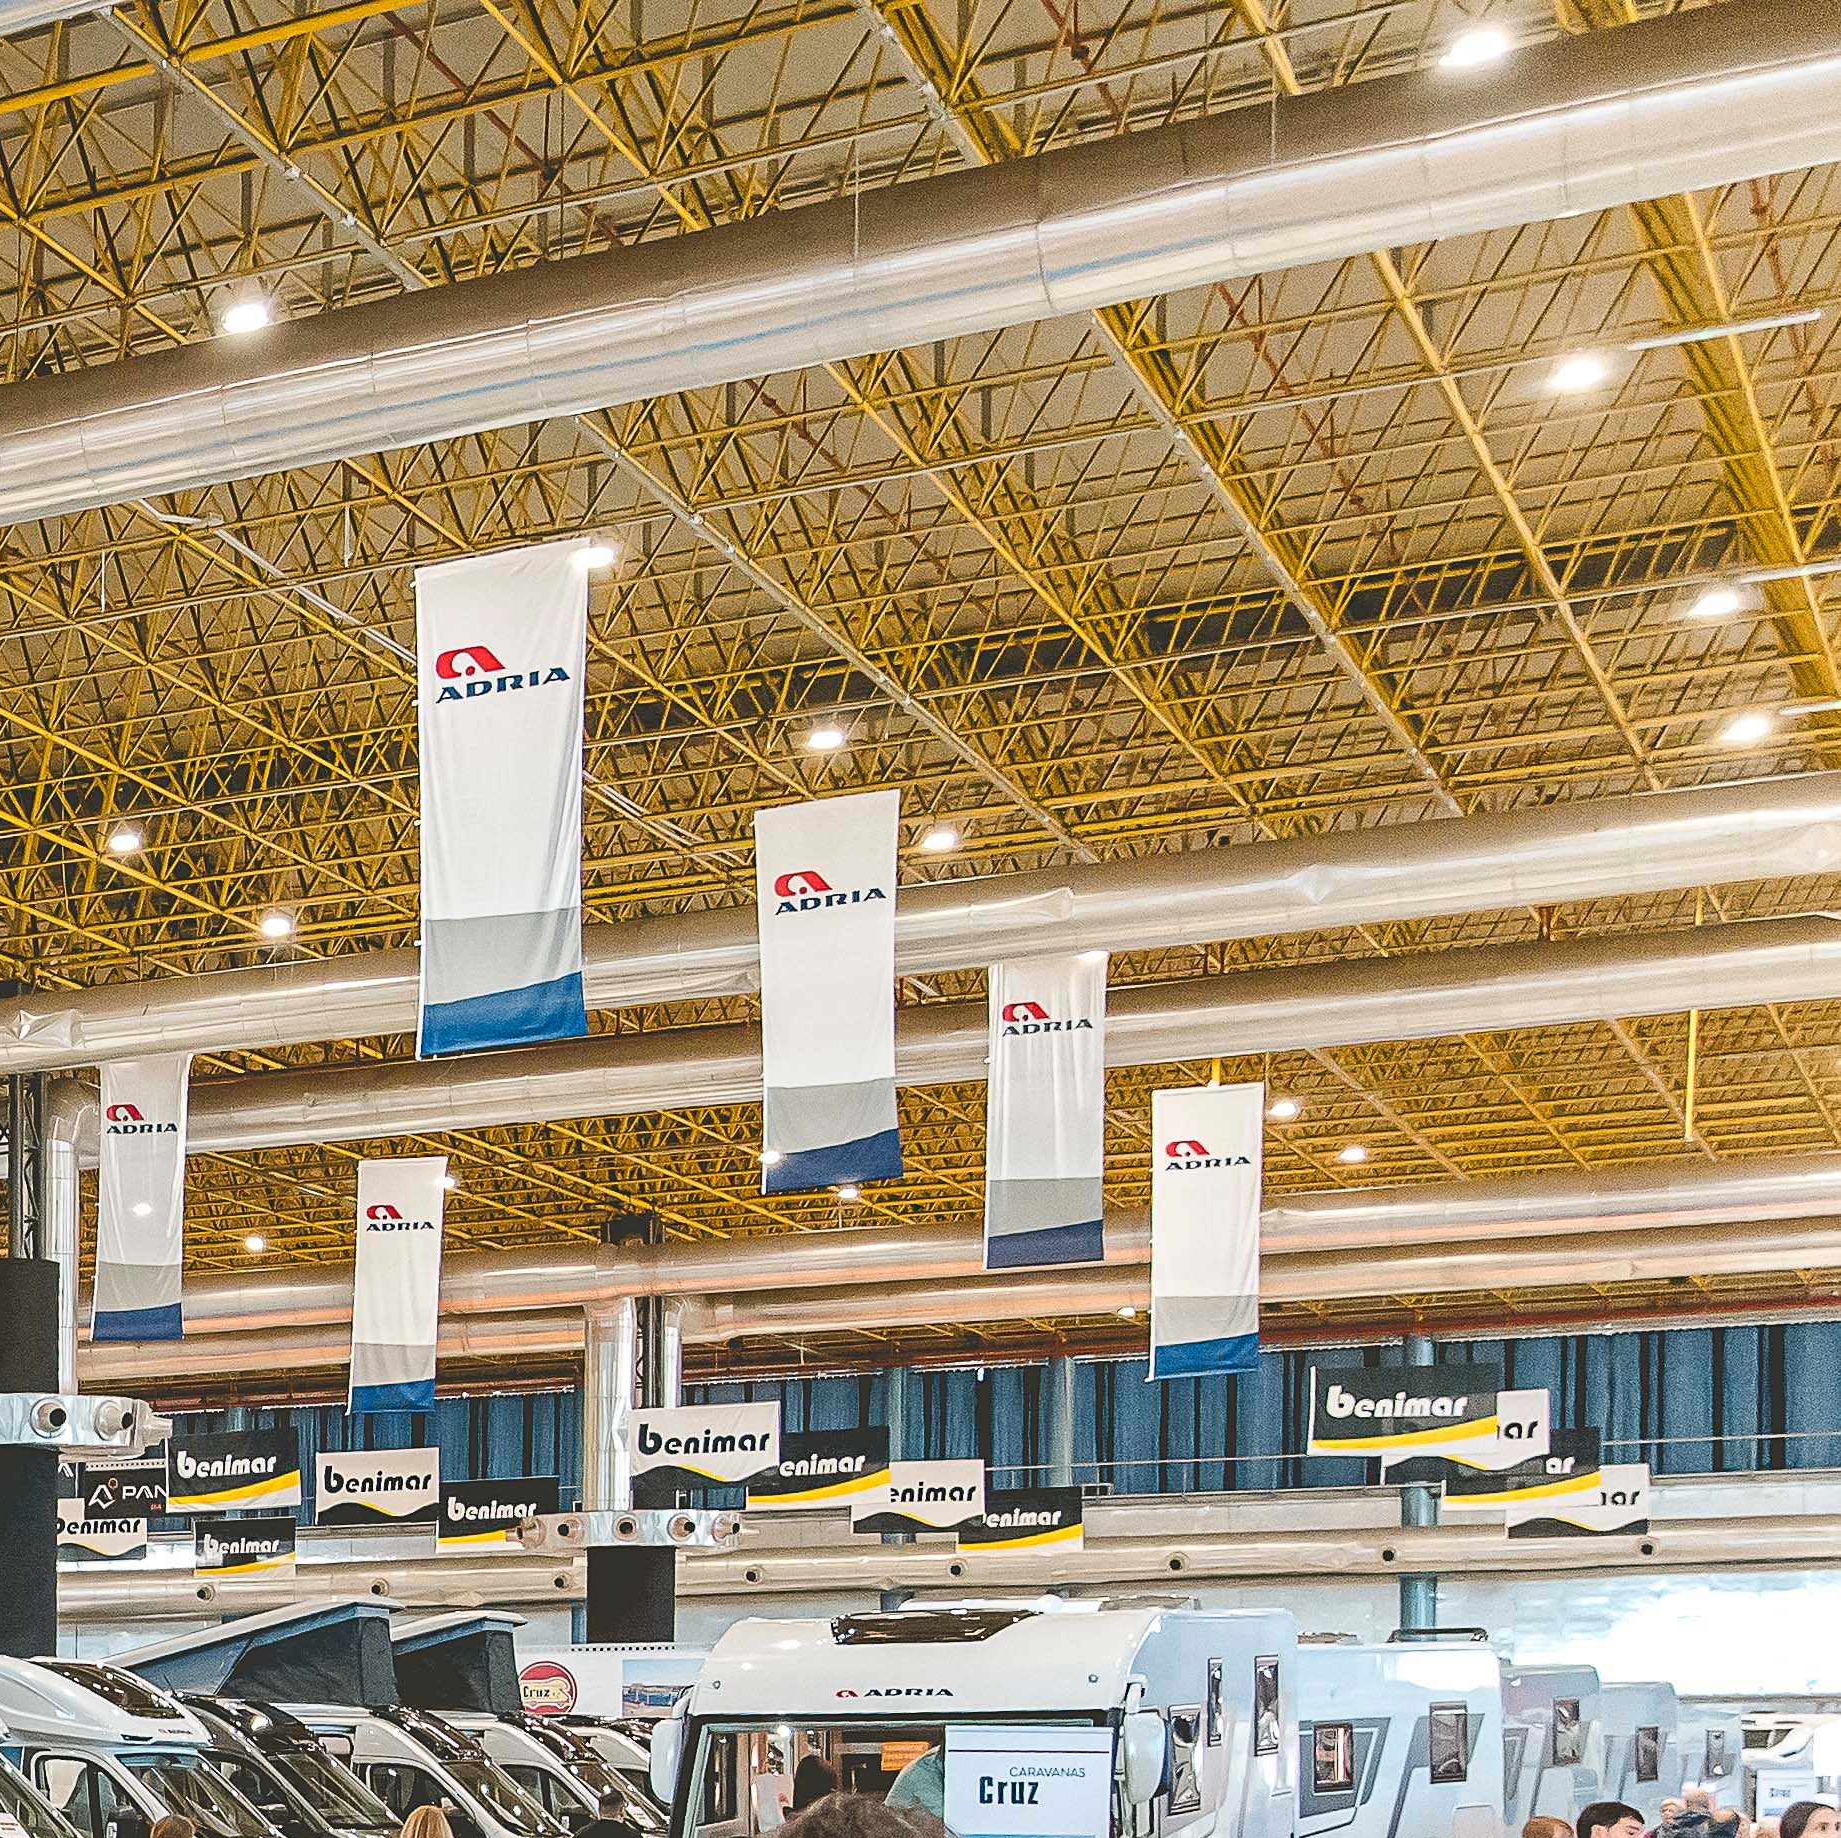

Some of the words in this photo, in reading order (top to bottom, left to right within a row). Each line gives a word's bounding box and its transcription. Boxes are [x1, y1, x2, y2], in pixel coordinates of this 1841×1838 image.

[436, 665, 570, 703] ADRIA
[775, 886, 887, 917] ADRIA
[1002, 1016, 1094, 1037] ADRIA
[107, 1119, 178, 1135] ADRIA
[1165, 1153, 1252, 1171] ADRIA
[366, 1217, 436, 1233] ADRIA
[1326, 1385, 1469, 1419] benimar
[637, 1423, 771, 1456] benimar
[176, 1450, 278, 1480] benimar
[779, 1453, 866, 1478] enimar
[323, 1465, 433, 1495] benimar
[891, 1482, 976, 1504] enimar
[447, 1496, 537, 1522] benimar
[983, 1508, 1062, 1529] enimar
[523, 1686, 550, 1698] Cruz
[864, 1688, 955, 1697] ADRIA
[1009, 1767, 1086, 1778] CARAVANAS
[979, 1776, 1040, 1805] Cruz
